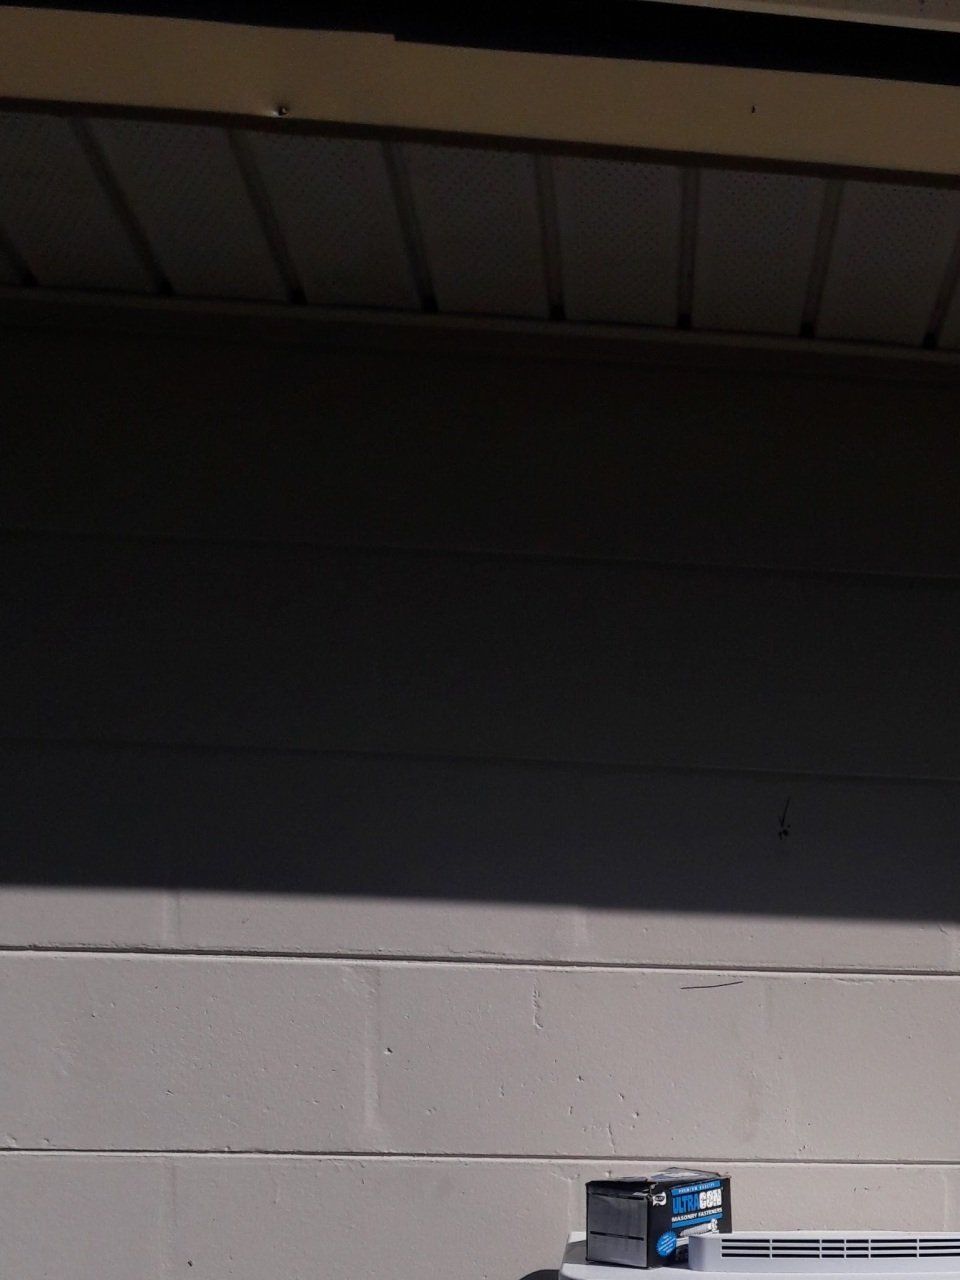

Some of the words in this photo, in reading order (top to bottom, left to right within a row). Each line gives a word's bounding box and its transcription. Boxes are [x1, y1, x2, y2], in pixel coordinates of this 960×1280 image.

[672, 1188, 722, 1214] ULTRACON
[671, 1213, 698, 1222] MASONRY
[698, 1207, 723, 1217] FASTENERS
